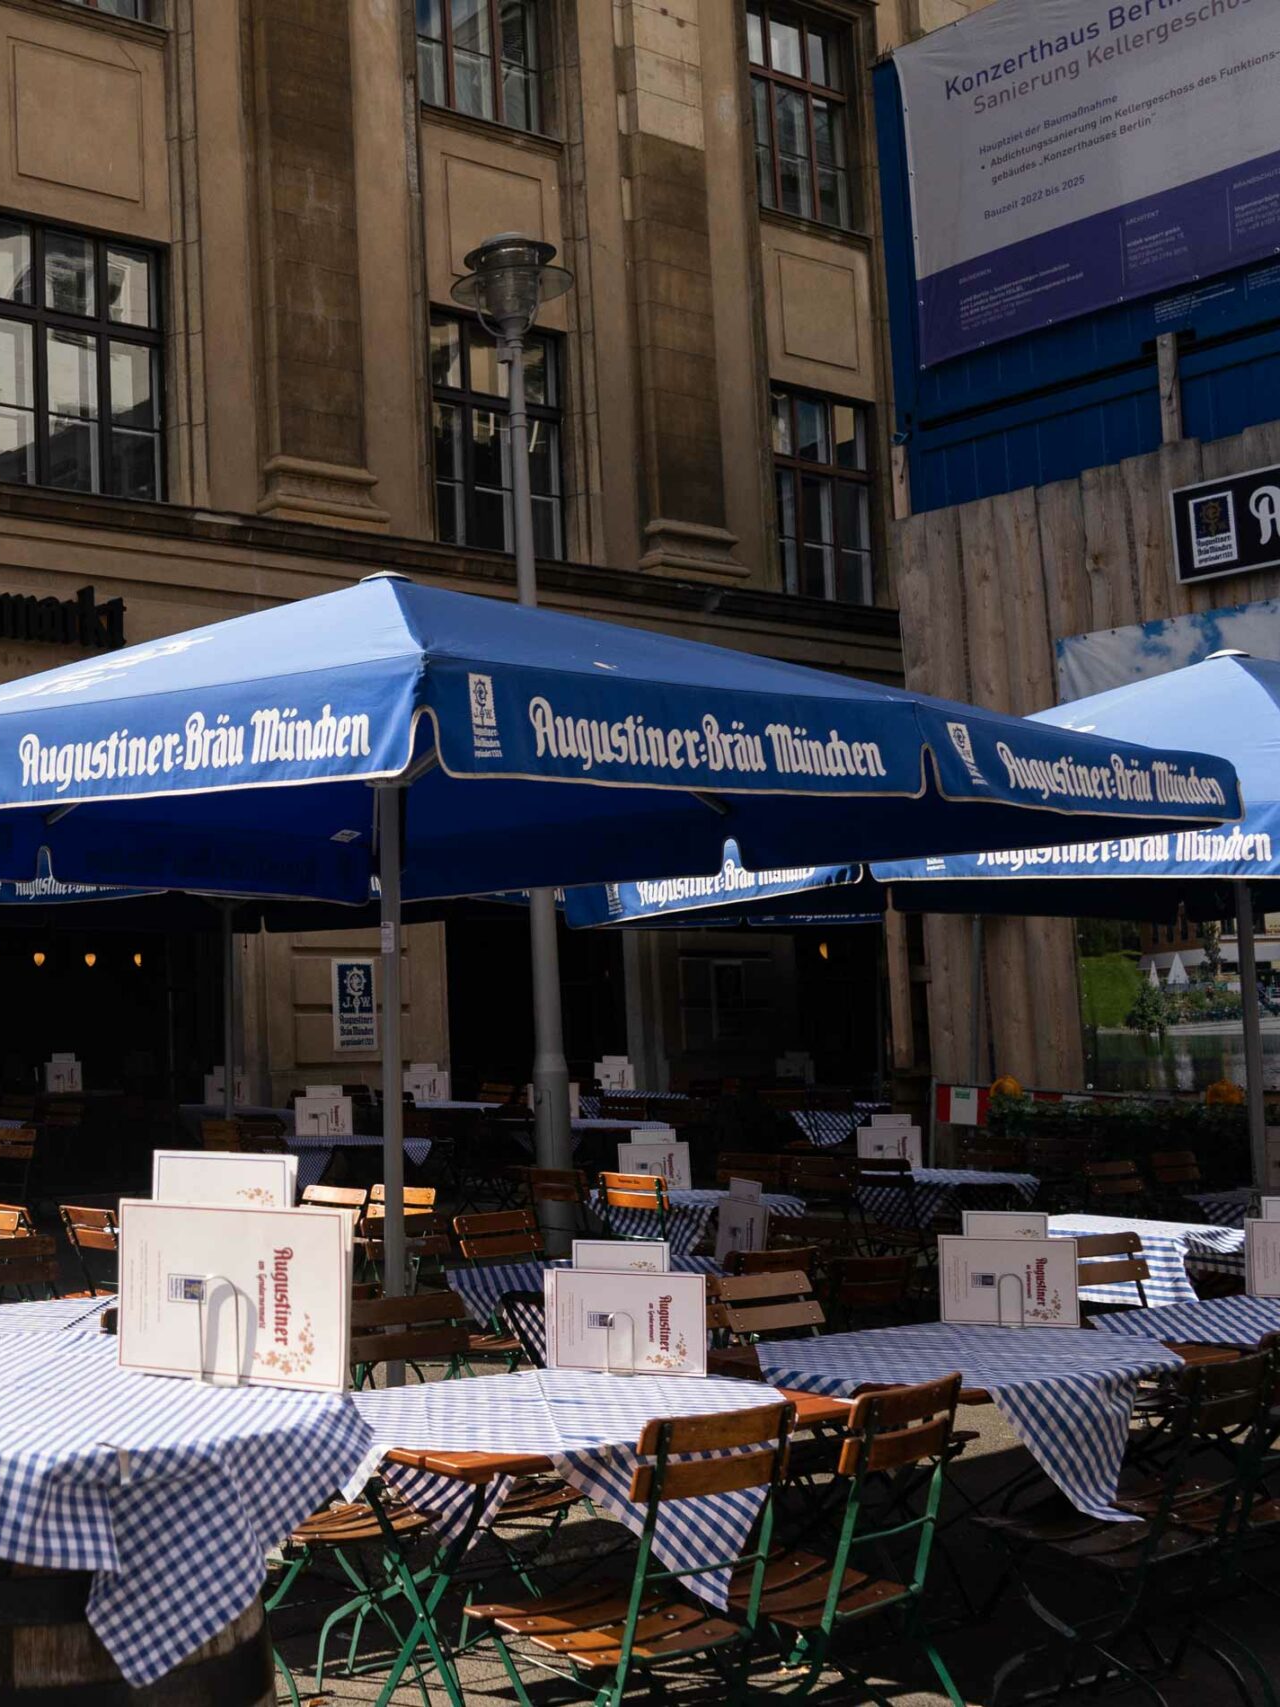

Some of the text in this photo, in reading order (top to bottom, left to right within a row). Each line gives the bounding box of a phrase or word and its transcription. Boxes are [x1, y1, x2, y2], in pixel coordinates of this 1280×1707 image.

[945, 21, 1100, 101] Konzerthaus
[973, 57, 1080, 114] Sanierung
[978, 95, 1118, 155] Hauptziel der Baumaßnahme
[990, 120, 1097, 168] Abdichtungssanierung
[1099, 114, 1112, 125] im
[1114, 83, 1195, 120] Kellergeschoss
[1197, 75, 1217, 87] des
[984, 174, 1085, 220] Bauzeit 2022 bis 2025
[991, 160, 1037, 185] gebäudes
[250, 703, 372, 764] München
[766, 721, 888, 778] München
[1151, 759, 1226, 806] München
[270, 1246, 294, 1347] Augustiner
[1033, 1257, 1048, 1308] Augustiner
[657, 1294, 673, 1353] Augustiner
